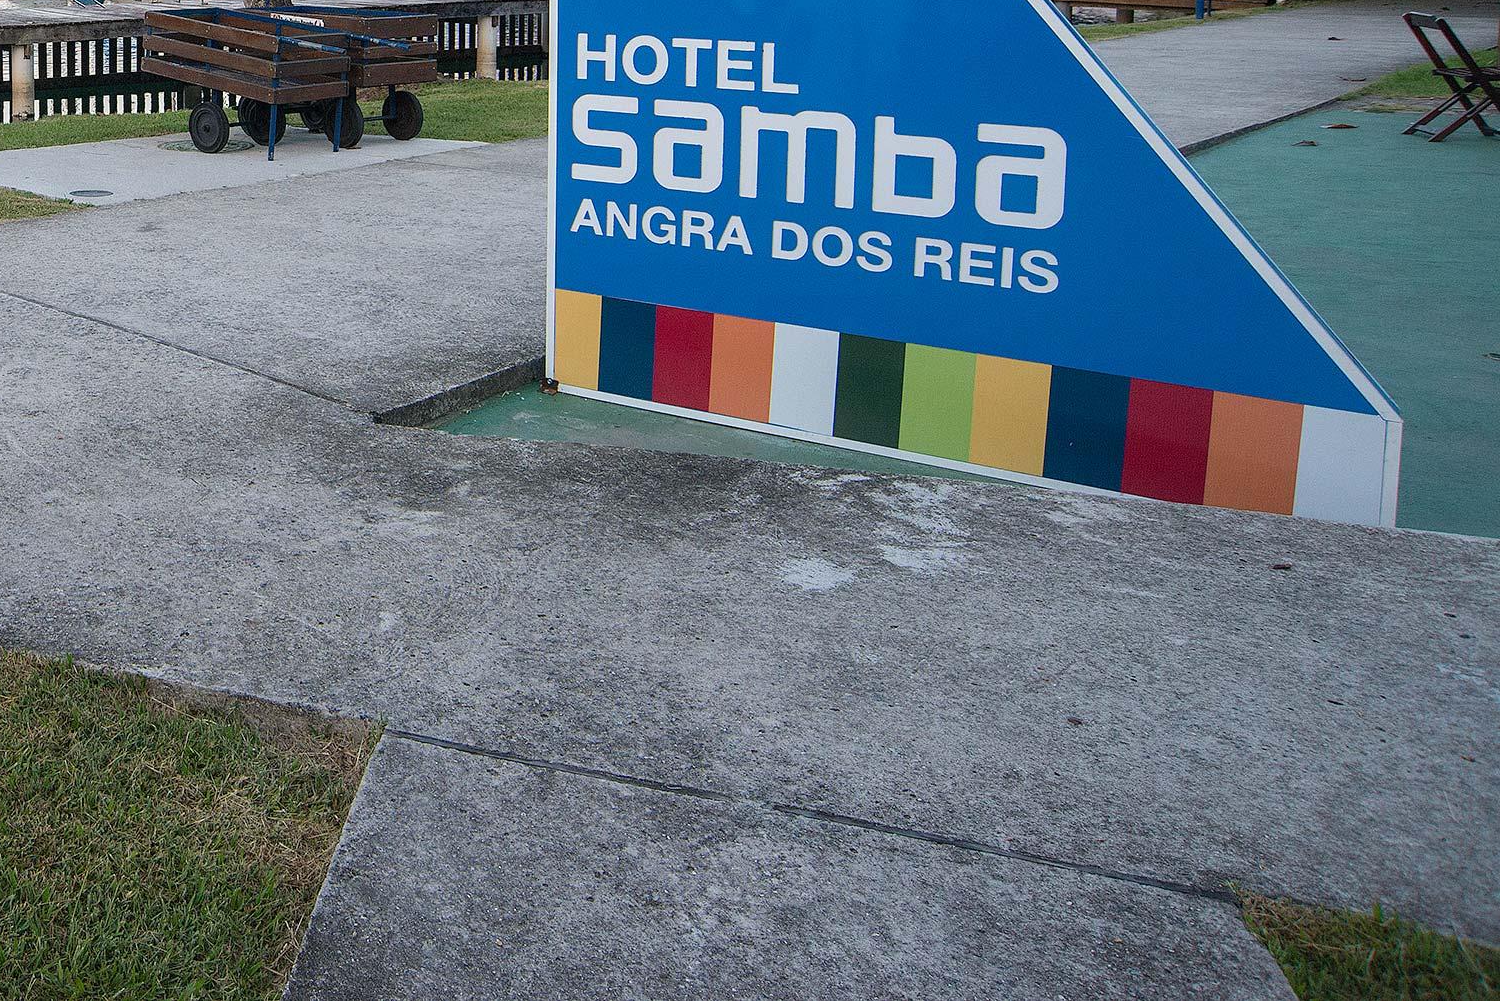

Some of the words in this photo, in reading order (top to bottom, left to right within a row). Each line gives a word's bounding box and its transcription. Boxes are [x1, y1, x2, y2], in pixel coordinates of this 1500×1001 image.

[577, 33, 799, 94] HOTEL
[571, 94, 1067, 230] samba
[570, 198, 753, 255] ANGRA
[772, 220, 893, 273] DOS
[913, 237, 1059, 294] REIS
